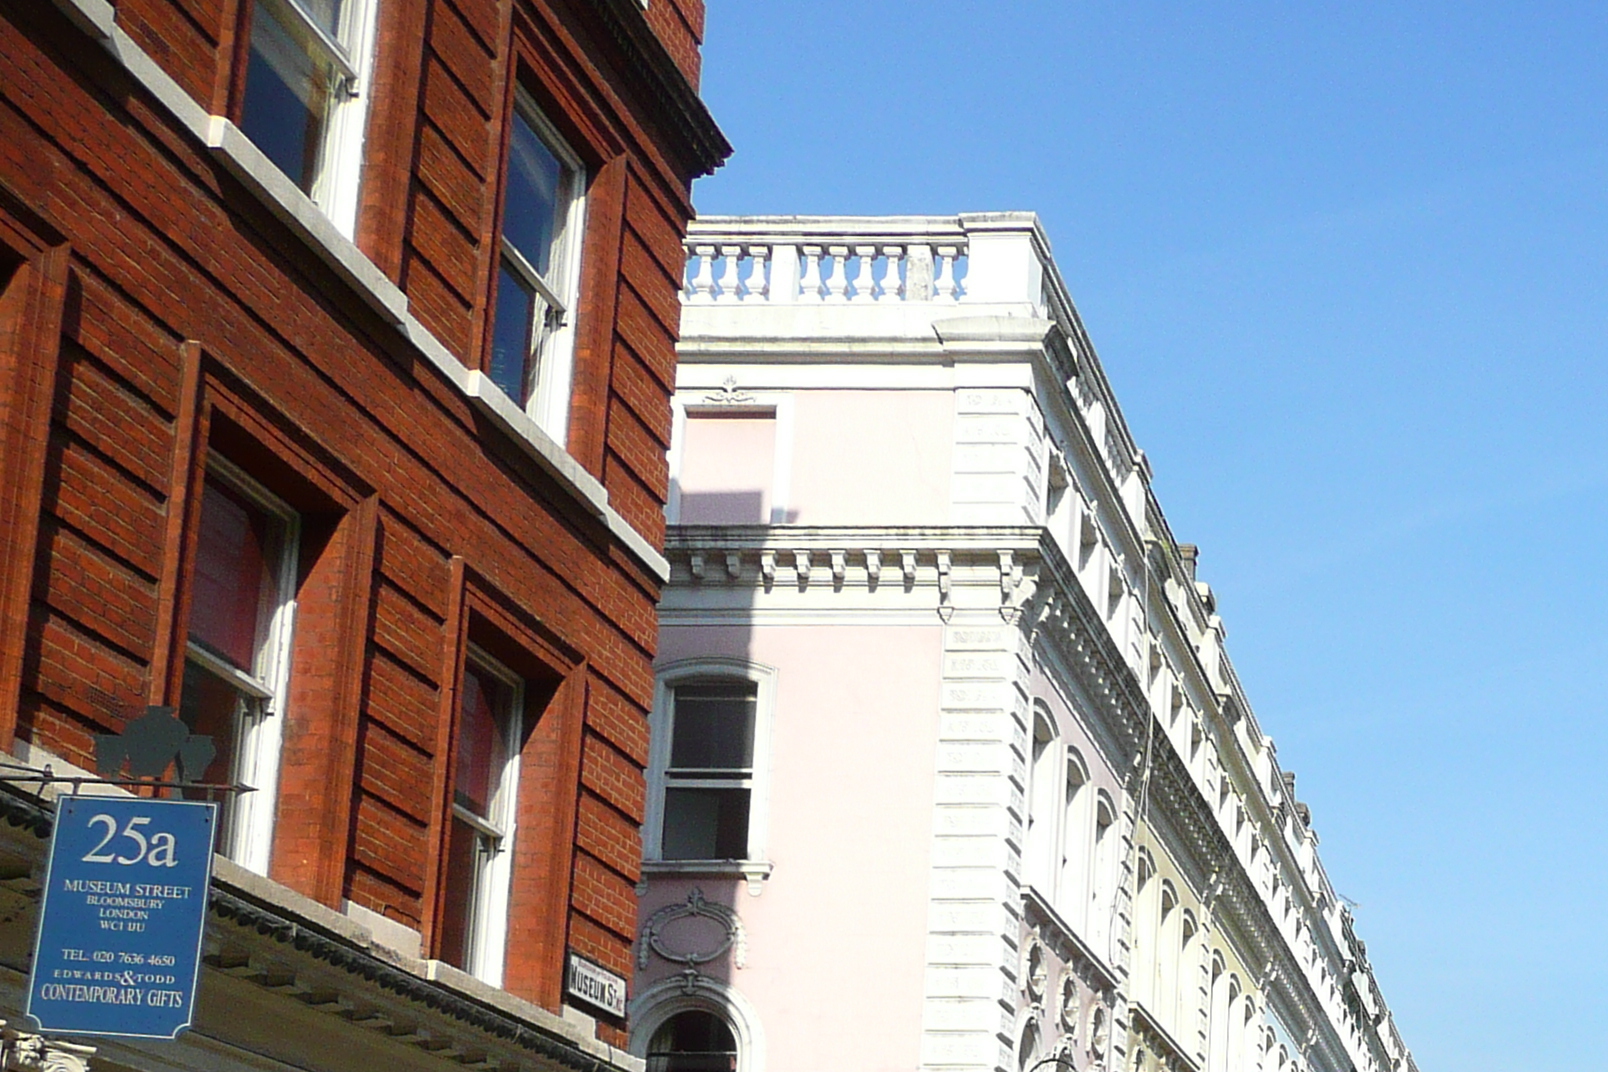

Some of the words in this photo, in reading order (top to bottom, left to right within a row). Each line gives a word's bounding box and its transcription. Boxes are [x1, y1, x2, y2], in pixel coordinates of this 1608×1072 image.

[81, 814, 178, 867] 25a
[64, 879, 130, 896] MUSEUM
[135, 884, 192, 899] STREET
[86, 895, 165, 909] BLOOMSBURY
[99, 908, 149, 920] LONDON
[62, 949, 90, 961] TEL.
[93, 951, 114, 963] 020
[118, 953, 145, 965] 7636
[148, 955, 176, 967] 4650
[570, 964, 606, 1004] MUSEUM
[41, 983, 143, 1005] CONTEMPORARY
[147, 989, 183, 1008] GIFTS
